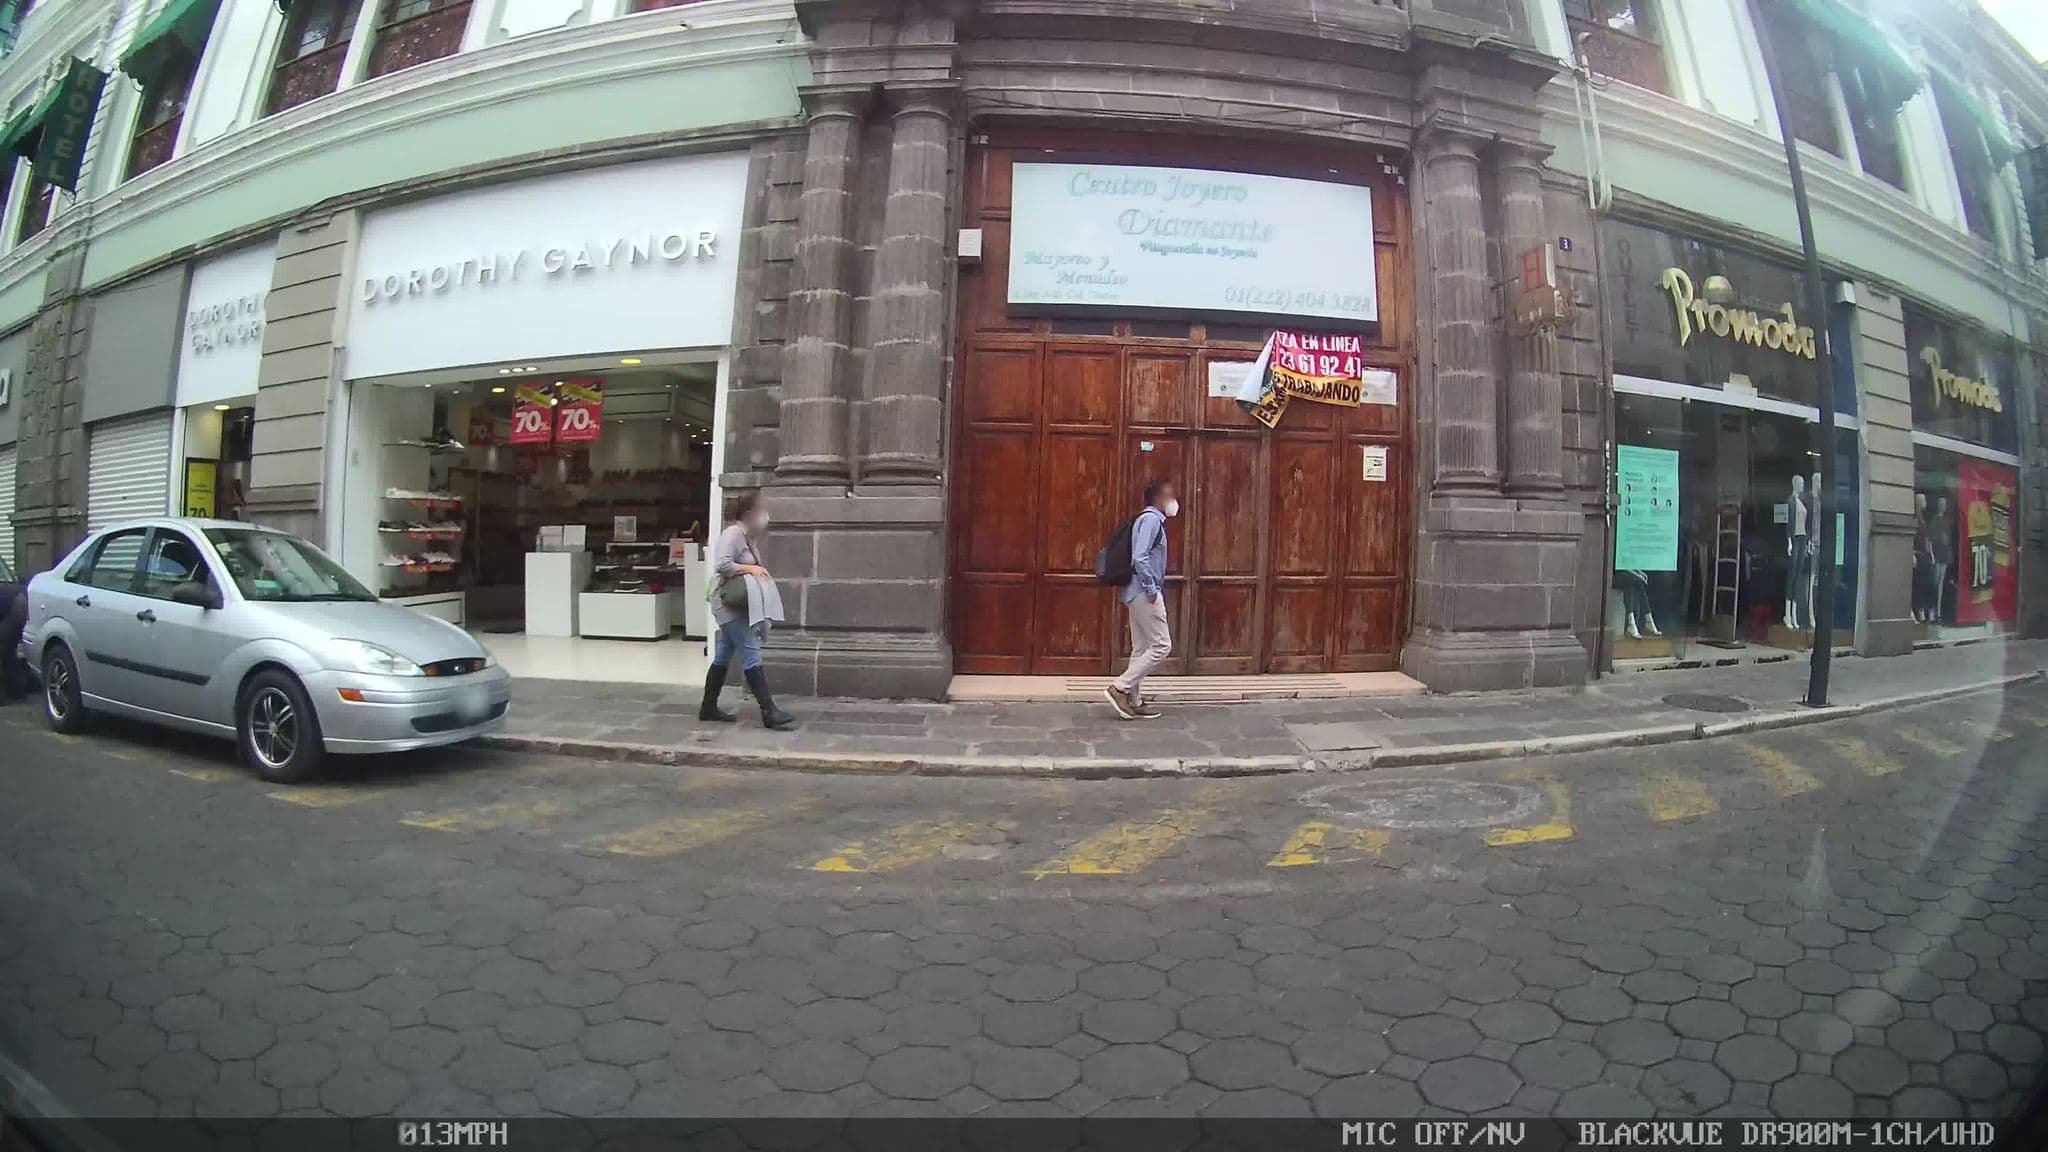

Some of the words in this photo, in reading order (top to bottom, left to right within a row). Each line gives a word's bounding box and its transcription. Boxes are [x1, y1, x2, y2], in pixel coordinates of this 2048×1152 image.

[49, 66, 98, 183] HOTEL
[1071, 171, 1157, 198] Centro
[1164, 175, 1248, 209] Joyero
[1118, 208, 1275, 244] Diamante
[362, 249, 526, 303] DOROTHY
[543, 231, 718, 274] GAYNOR
[190, 295, 260, 326] DOROTH
[1662, 267, 1816, 360] Promoda
[1302, 335, 1319, 350] EN
[1319, 355, 1341, 377] 92
[1283, 373, 1360, 403] TRABAJANDO
